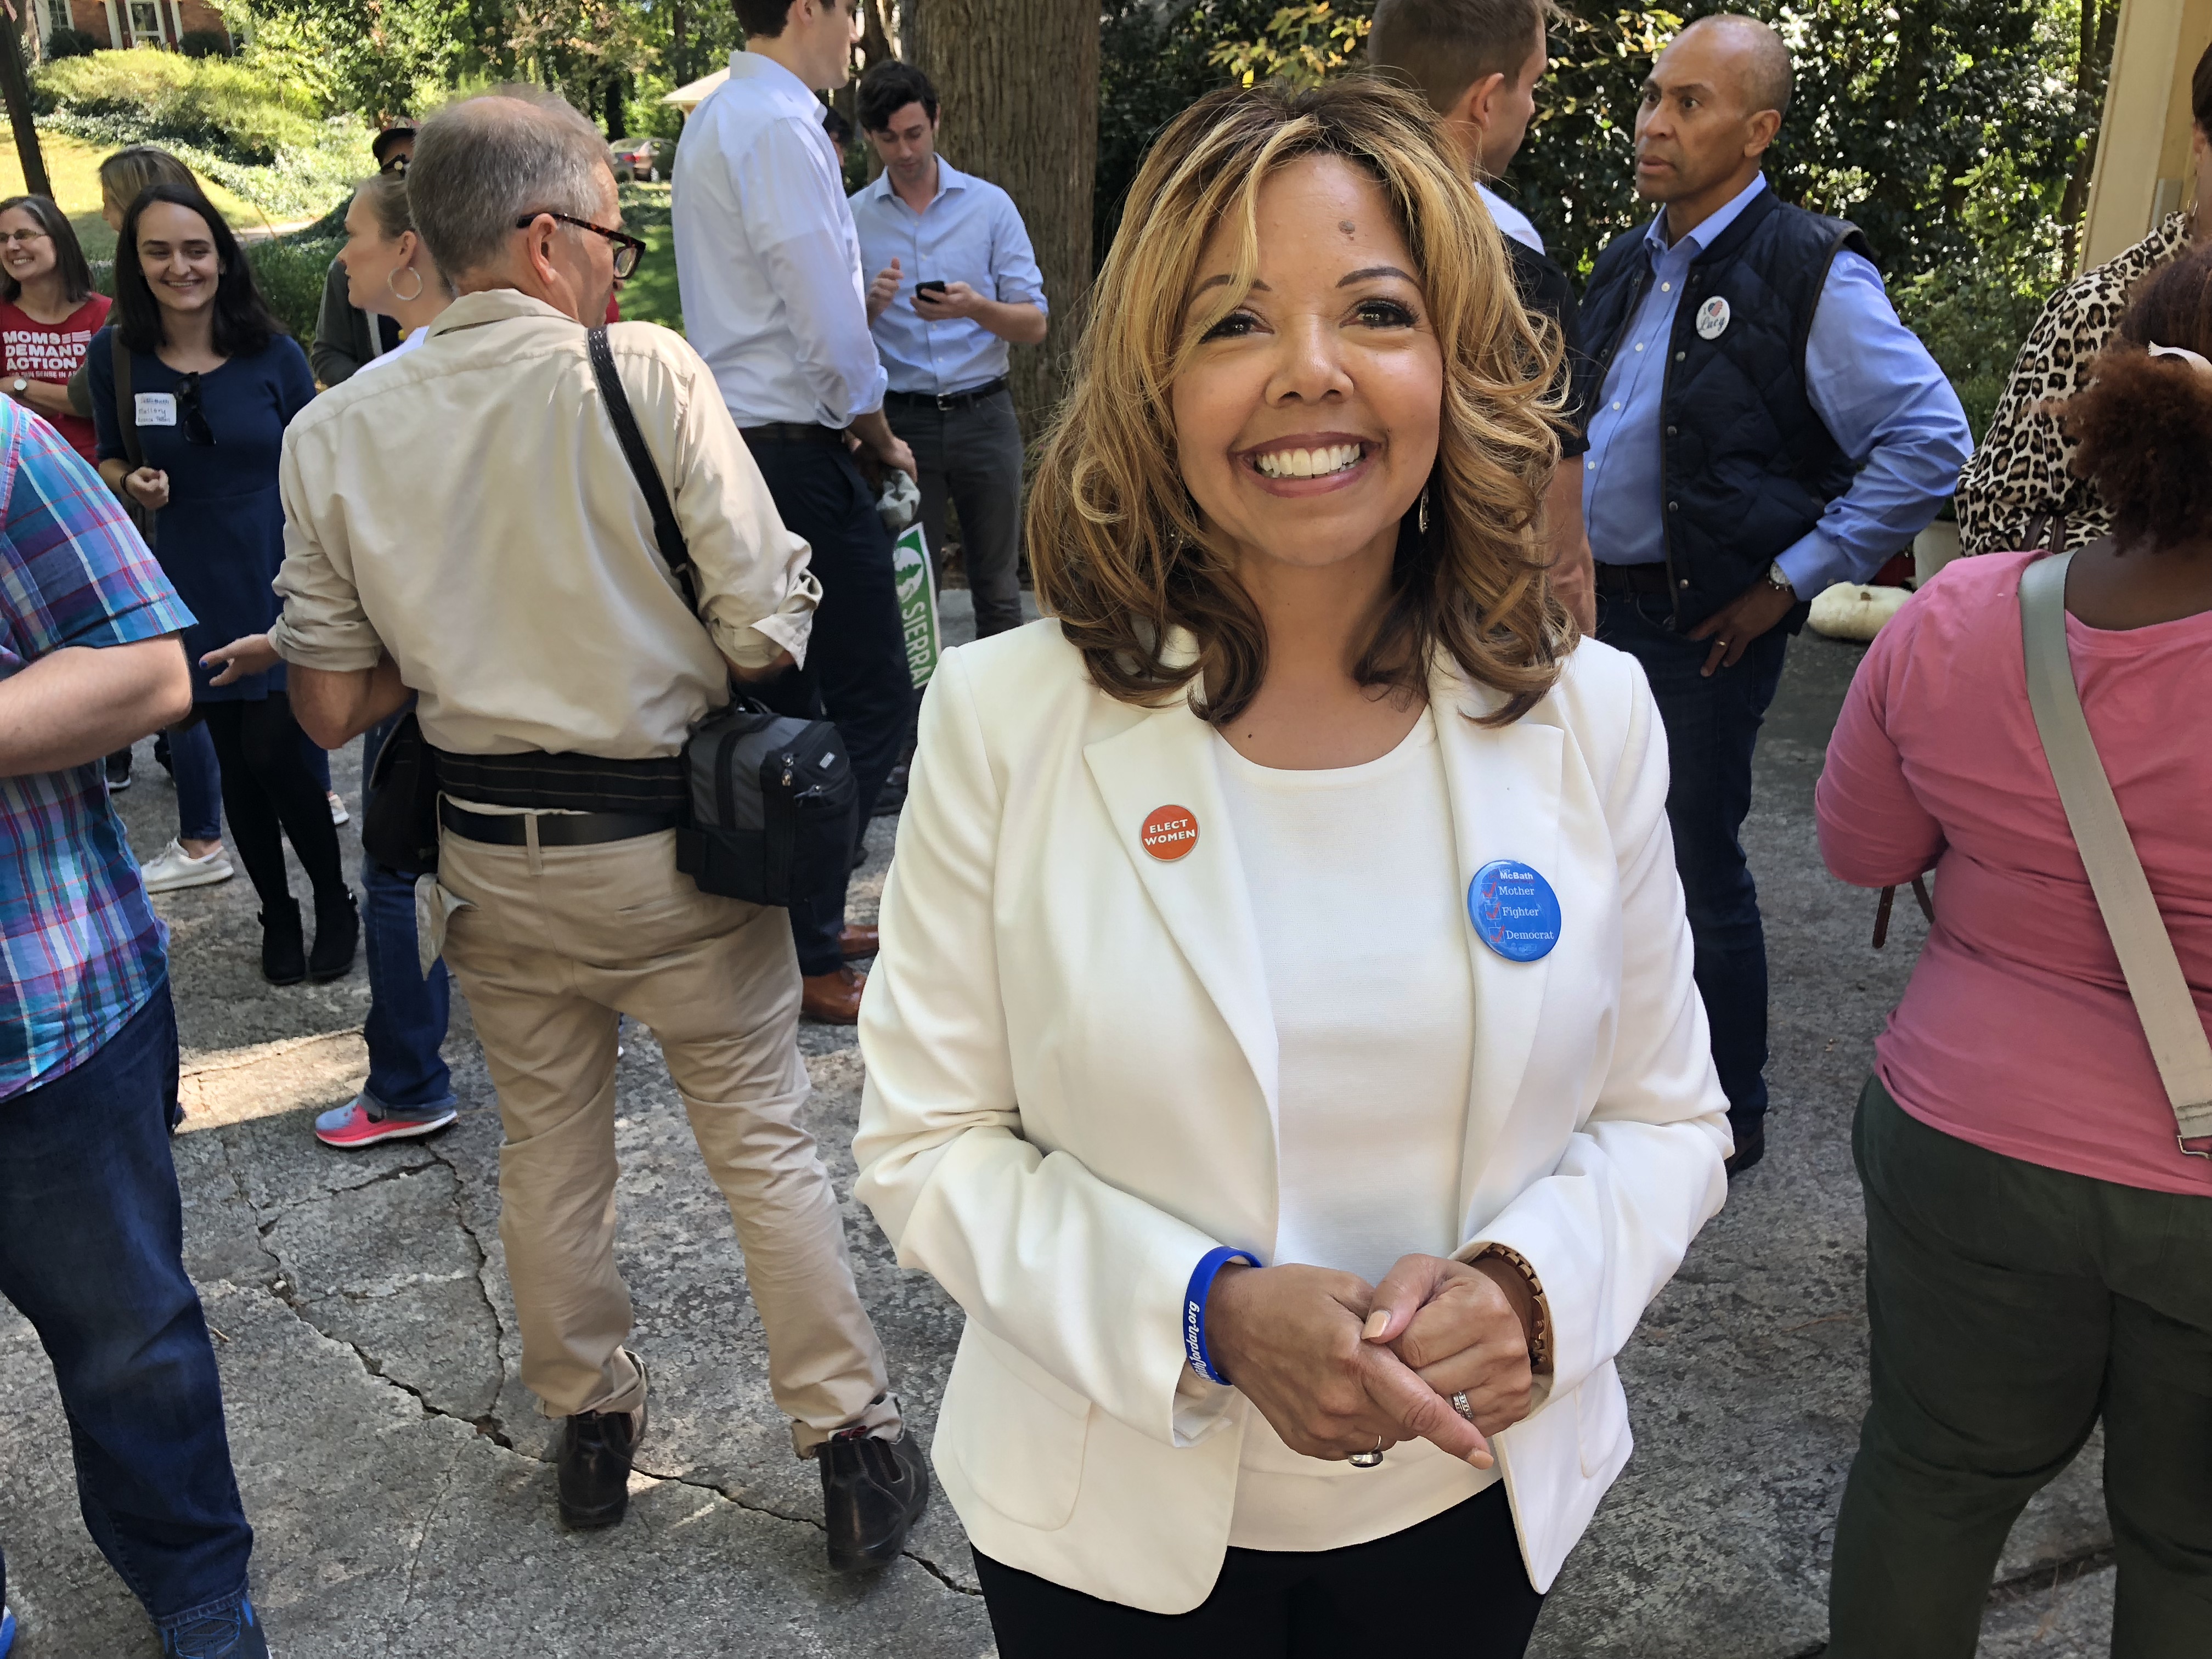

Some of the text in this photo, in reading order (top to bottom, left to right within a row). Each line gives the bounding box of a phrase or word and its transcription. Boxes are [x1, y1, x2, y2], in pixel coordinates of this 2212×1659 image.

[1699, 316, 1725, 332] Lucy
[2, 330, 61, 345] MOMS
[5, 343, 86, 357] DEMAND
[6, 357, 77, 371] ACTION
[902, 601, 932, 682] SIERRA
[1149, 819, 1188, 834] ELECT
[1144, 829, 1196, 846] WOMEN
[1498, 886, 1534, 895] Mother
[1502, 906, 1539, 919] Fighter
[1505, 930, 1554, 940] Democrat
